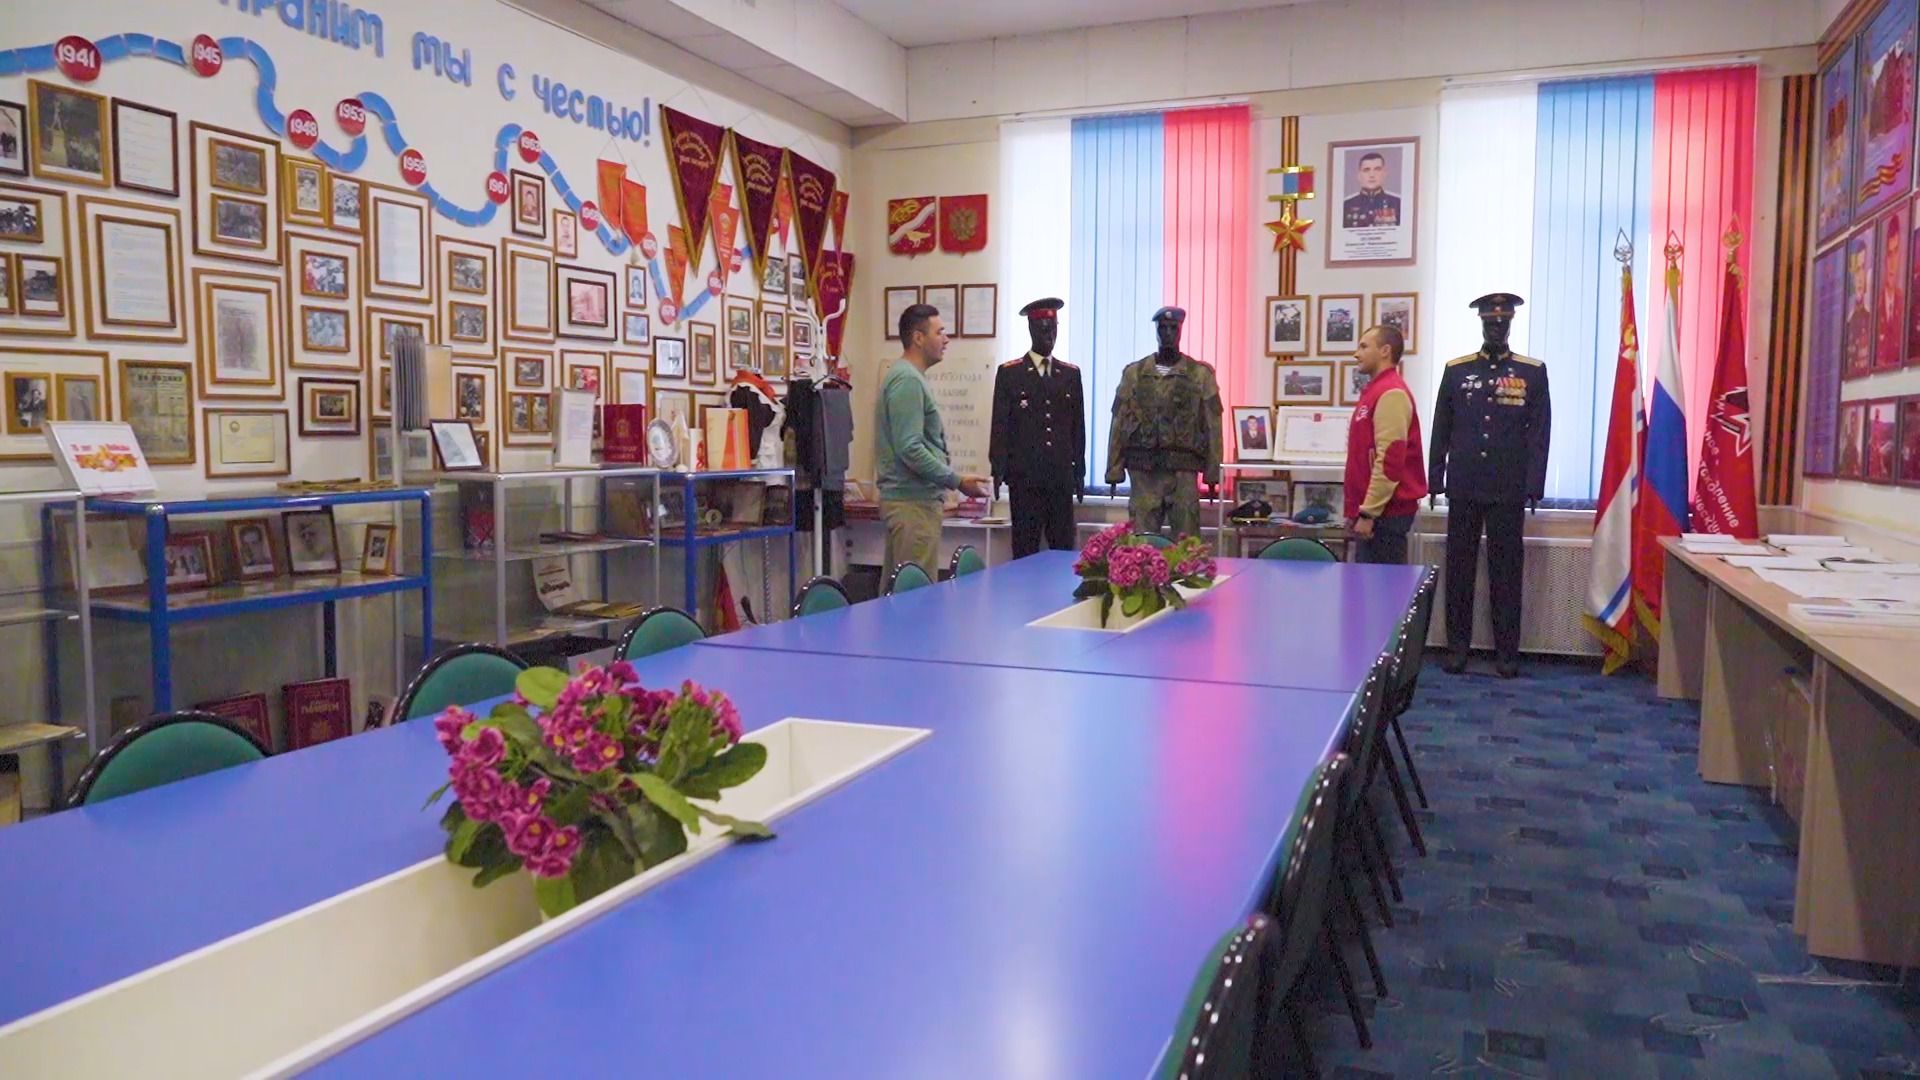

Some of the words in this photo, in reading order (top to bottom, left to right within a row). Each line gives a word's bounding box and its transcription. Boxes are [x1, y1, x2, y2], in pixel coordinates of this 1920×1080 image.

[58, 44, 96, 68] 1941
[194, 44, 221, 65] 1945
[219, 0, 384, 58] аним
[412, 31, 472, 87] мы
[497, 63, 516, 101] с
[532, 74, 651, 147] честью!
[339, 103, 365, 123] 1953
[290, 118, 317, 137] 1948
